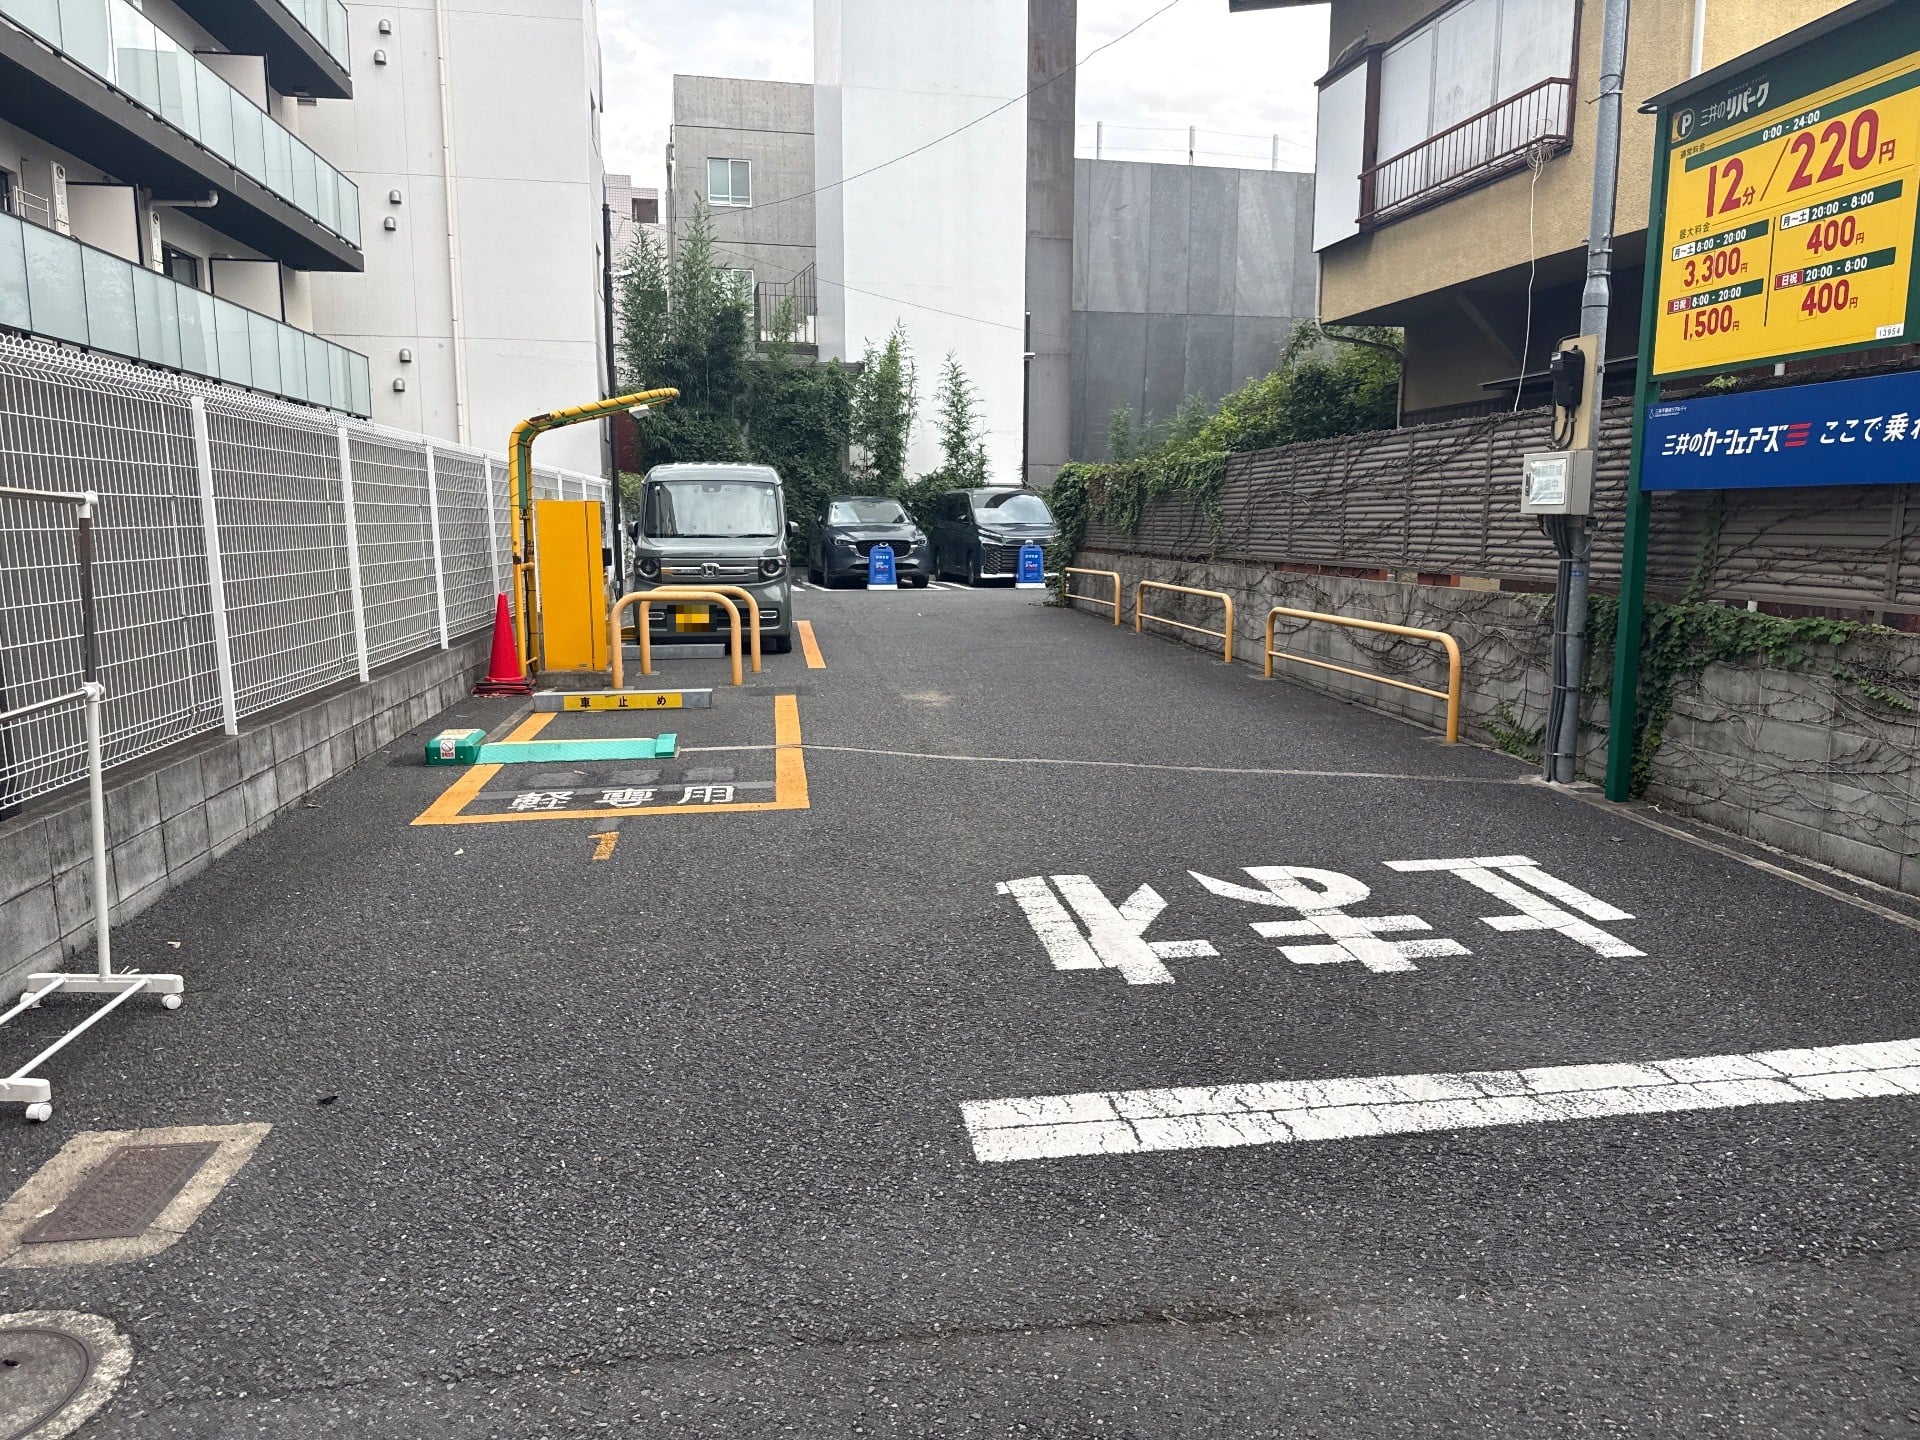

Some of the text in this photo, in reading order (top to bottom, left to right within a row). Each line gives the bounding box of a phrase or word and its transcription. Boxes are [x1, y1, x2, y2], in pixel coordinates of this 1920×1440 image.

[1700, 82, 1770, 127] 三井のリパーク
[1763, 125, 1783, 141] 0:00
[1793, 110, 1821, 129] 24:00
[1811, 202, 1839, 220] 20:00
[1851, 191, 1874, 208] 8:00
[1696, 239, 1714, 252] 8:00
[1723, 229, 1747, 245] 20:00
[1807, 215, 1865, 255] 400円
[1684, 247, 1748, 287] 3,300円
[1781, 273, 1798, 286] 日祝
[1805, 265, 1833, 282] 20:00
[1845, 257, 1867, 272] 8:00
[1692, 294, 1709, 307] 8:00
[1718, 286, 1742, 301] 20:00
[1801, 279, 1858, 316] 400円
[1879, 327, 1901, 337] 13954
[1661, 424, 1789, 456] 三井のカーシェアーズ
[580, 696, 667, 708] 車止め
[507, 785, 735, 811] 軽専用
[995, 855, 1648, 985] 止まれ
